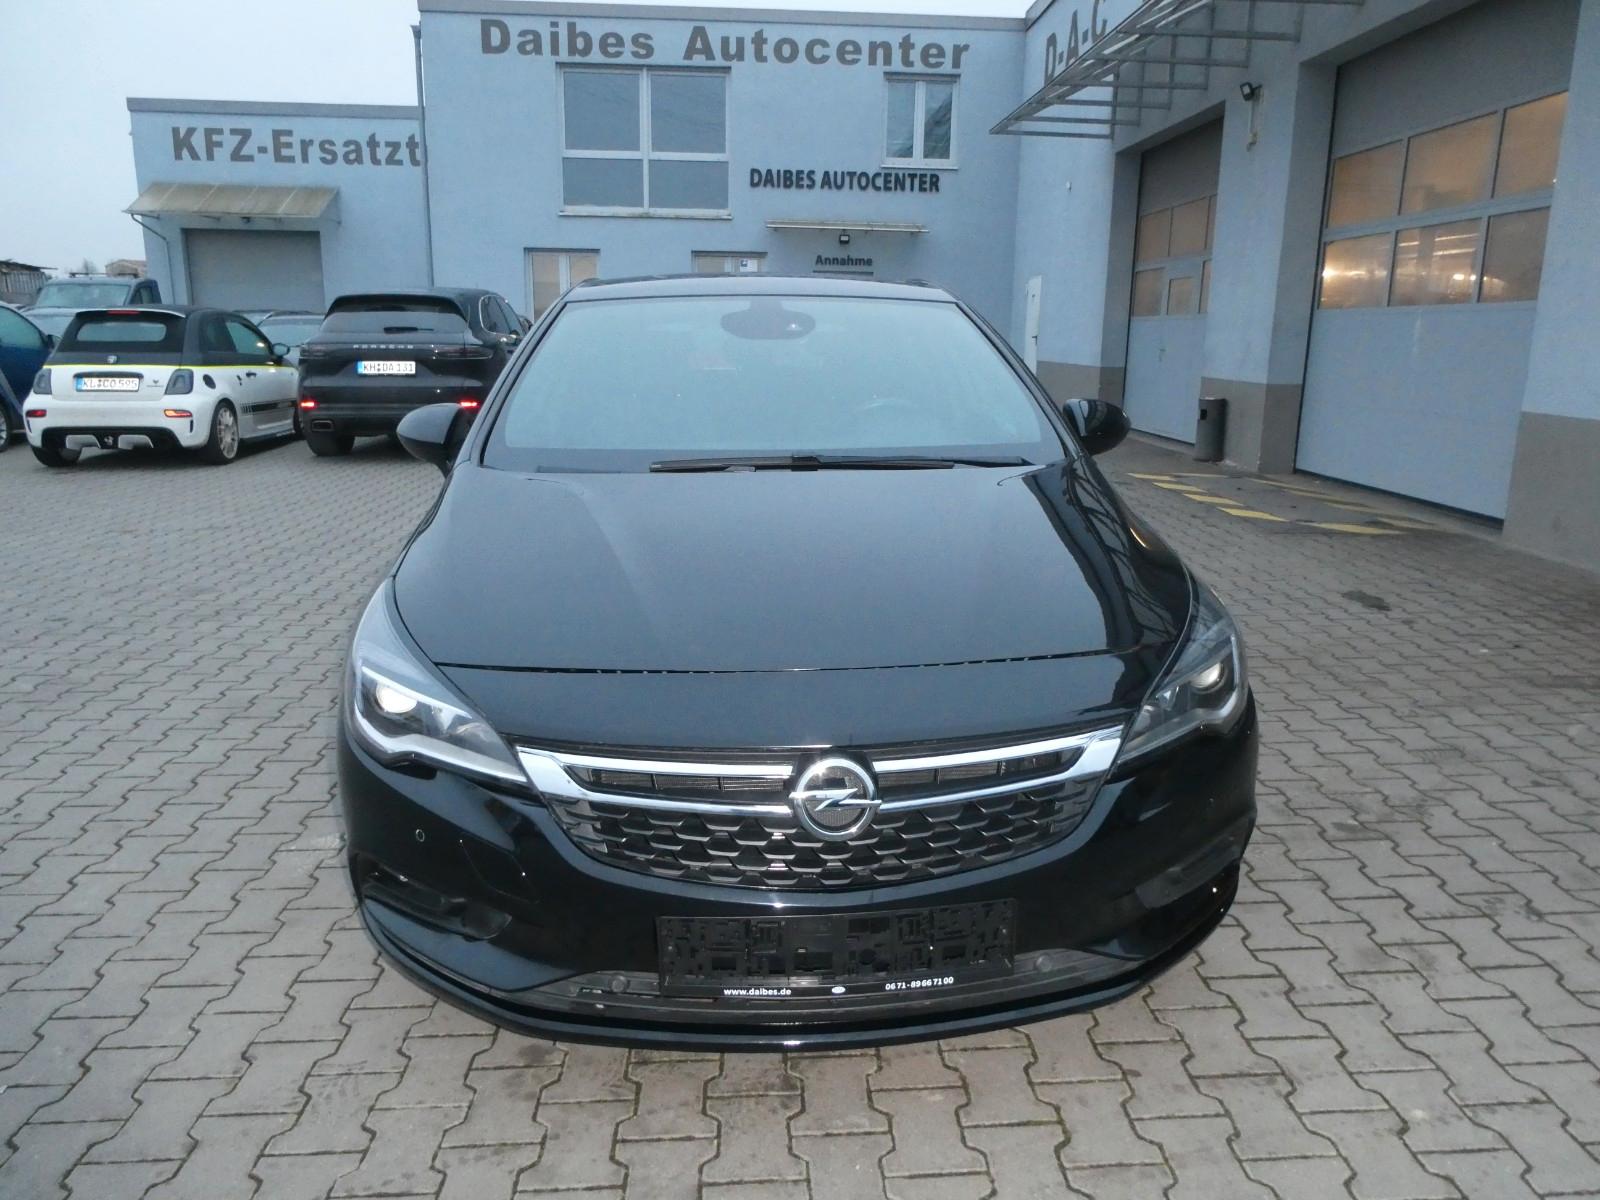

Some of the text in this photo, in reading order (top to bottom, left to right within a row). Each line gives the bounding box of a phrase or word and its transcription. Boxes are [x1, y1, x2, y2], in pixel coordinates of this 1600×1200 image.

[480, 18, 971, 70] Daibes Autocenter
[171, 126, 421, 166] KFZ-Ersatzt
[749, 167, 941, 194] DAIBES AUTOCENTER
[815, 254, 873, 266] Annahme
[723, 987, 792, 996] www.daibes.de
